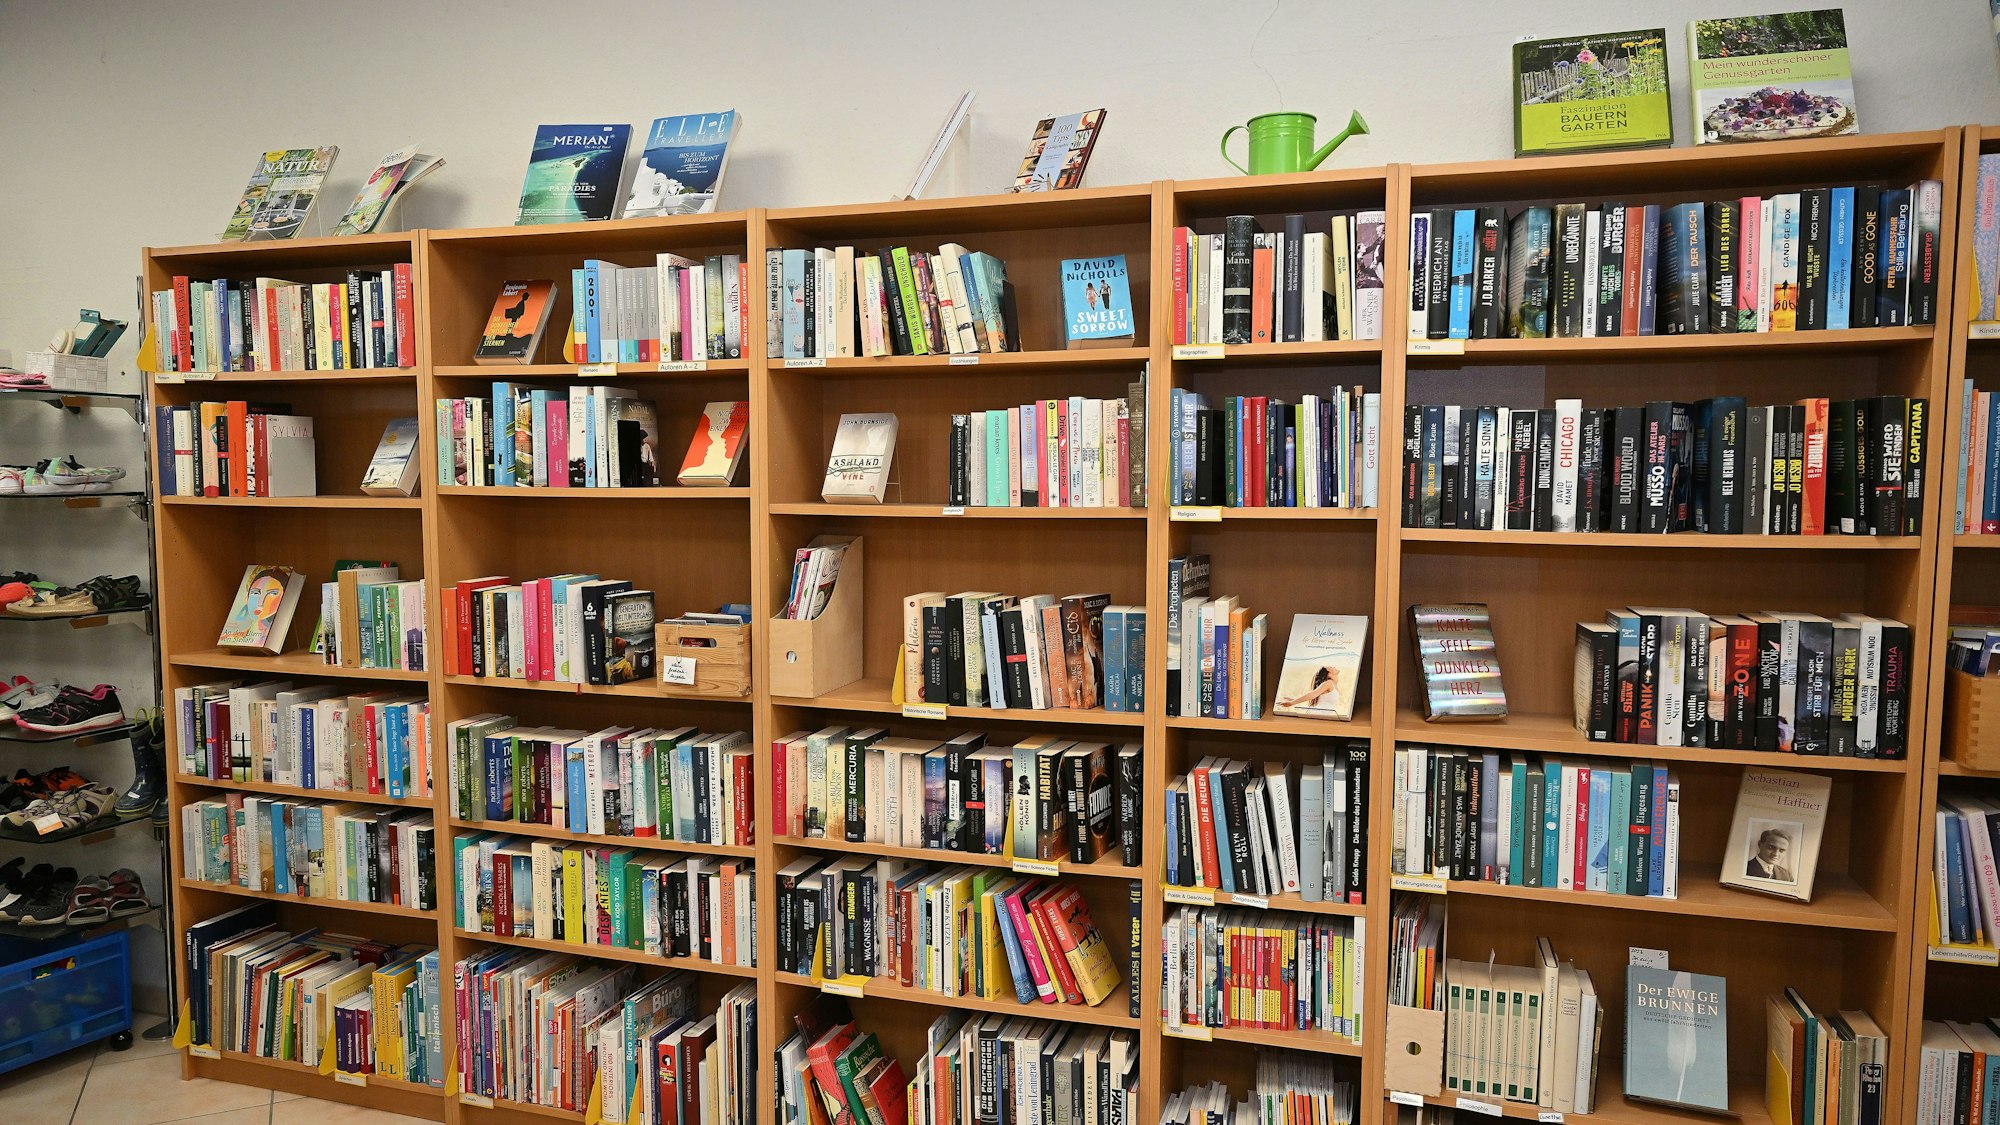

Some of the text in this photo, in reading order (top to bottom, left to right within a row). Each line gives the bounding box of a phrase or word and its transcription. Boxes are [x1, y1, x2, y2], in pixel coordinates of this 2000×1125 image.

[1703, 53, 1833, 69] Mein wunderschöner
[1703, 66, 1792, 79] Genussgarten
[1560, 103, 1627, 112] Faszination
[1560, 111, 1627, 122] BAUERN
[655, 133, 725, 144] TRAVELLER
[657, 113, 728, 138] ELLE
[1052, 134, 1069, 142] Tips
[1056, 123, 1073, 134] 100
[1561, 120, 1627, 131] GARTEN
[553, 136, 609, 145] MERIAN
[1612, 206, 1624, 254] BURGER
[1690, 210, 1698, 250] TAUSCH
[1784, 208, 1792, 223] FOX
[1566, 214, 1580, 264] UNBEKANNTE
[1603, 214, 1611, 248] Wolfgang
[1720, 208, 1730, 271] LIED DES ZORNS
[1896, 204, 1908, 272] Stille Befreiung
[1226, 256, 1250, 264] Mann
[1864, 212, 1876, 284] GOOD GONE
[1886, 216, 1898, 289] PETRA HAMMESFAHR
[1924, 232, 1932, 284] GRABESSTERN
[898, 256, 908, 288] UNSCHULD
[1067, 269, 1125, 281] NICHOLLS
[1074, 260, 1115, 271] DAVID
[1432, 236, 1444, 304] FRIEDRICH ANI
[1721, 275, 1732, 306] FAHNERT
[1774, 298, 1796, 311] 606
[178, 303, 187, 356] AMERICAN
[1072, 320, 1128, 334] SORROW
[1077, 310, 1126, 323] SWEET
[272, 426, 308, 437] SYLVIA
[1185, 404, 1193, 470] LEBEN MEHR
[1514, 420, 1522, 452] FINSTER
[1522, 422, 1530, 449] NEBEL
[1560, 416, 1574, 468] CHICAGO
[1584, 424, 1592, 444] mich
[1650, 421, 1658, 450] ATELIER
[1910, 402, 1922, 464] CAPITANA
[1367, 426, 1375, 468] Gott lacht
[1481, 417, 1492, 476] KALTE SONNE
[1808, 434, 1824, 470] ZIBULLA
[1888, 424, 1902, 486] SIE FINDEN
[833, 458, 879, 466] ASHLAND
[1620, 436, 1634, 504] BLOOD WORLD
[1722, 449, 1734, 496] NELE NEUHAUS
[1650, 466, 1664, 507] MUSSO
[587, 603, 593, 611] 6
[619, 603, 646, 613] GENERATION
[1169, 570, 1178, 629] Die Propheten
[615, 611, 652, 622] WELTUNTERGANG
[1204, 618, 1212, 637] MEHR
[1314, 625, 1344, 637] Wellness
[1436, 618, 1473, 631] KALTE
[908, 617, 918, 654] Malerin
[1440, 639, 1472, 652] SEELE
[1647, 624, 1656, 659] STARR
[1434, 660, 1490, 674] DUNKLES
[1734, 639, 1750, 697] ZONE
[1770, 649, 1778, 675] ZUVOR
[1816, 652, 1824, 673] MICH
[1867, 649, 1875, 679] WINSLOW
[1886, 647, 1897, 693] TRAUMA
[1203, 684, 1212, 692] 20
[1203, 693, 1212, 701] 25
[1450, 682, 1483, 695] HERZ
[1623, 681, 1633, 713] Shaw
[1842, 648, 1856, 722] MURDER PARK
[1641, 684, 1653, 728] PANIK
[1664, 693, 1672, 725] Camilla
[1687, 695, 1696, 727] Camilla
[1696, 702, 1705, 723] Sten
[1040, 756, 1050, 800] HABITAT
[1470, 768, 1479, 816] Unkaputtbar
[1748, 774, 1800, 789] Sebastian
[1089, 784, 1112, 817] FUTURE
[1636, 784, 1647, 825] Eisgesang
[1653, 775, 1666, 848] MUTTERBLUES
[1777, 795, 1823, 811] Haffner
[1233, 833, 1242, 862] EVELYN
[1396, 880, 1442, 890] Erfahrungsberichte
[600, 880, 610, 934] DESPENTES
[1132, 917, 1140, 948] Vater
[1169, 943, 1177, 969] Berlin
[549, 966, 578, 986] Strick
[1132, 961, 1140, 1002] ALLES
[652, 987, 682, 1011] Büro
[1638, 984, 1719, 1003] Der EWIGE
[1638, 996, 1719, 1016] BRUNNEN
[432, 1004, 440, 1053] Italienisch
